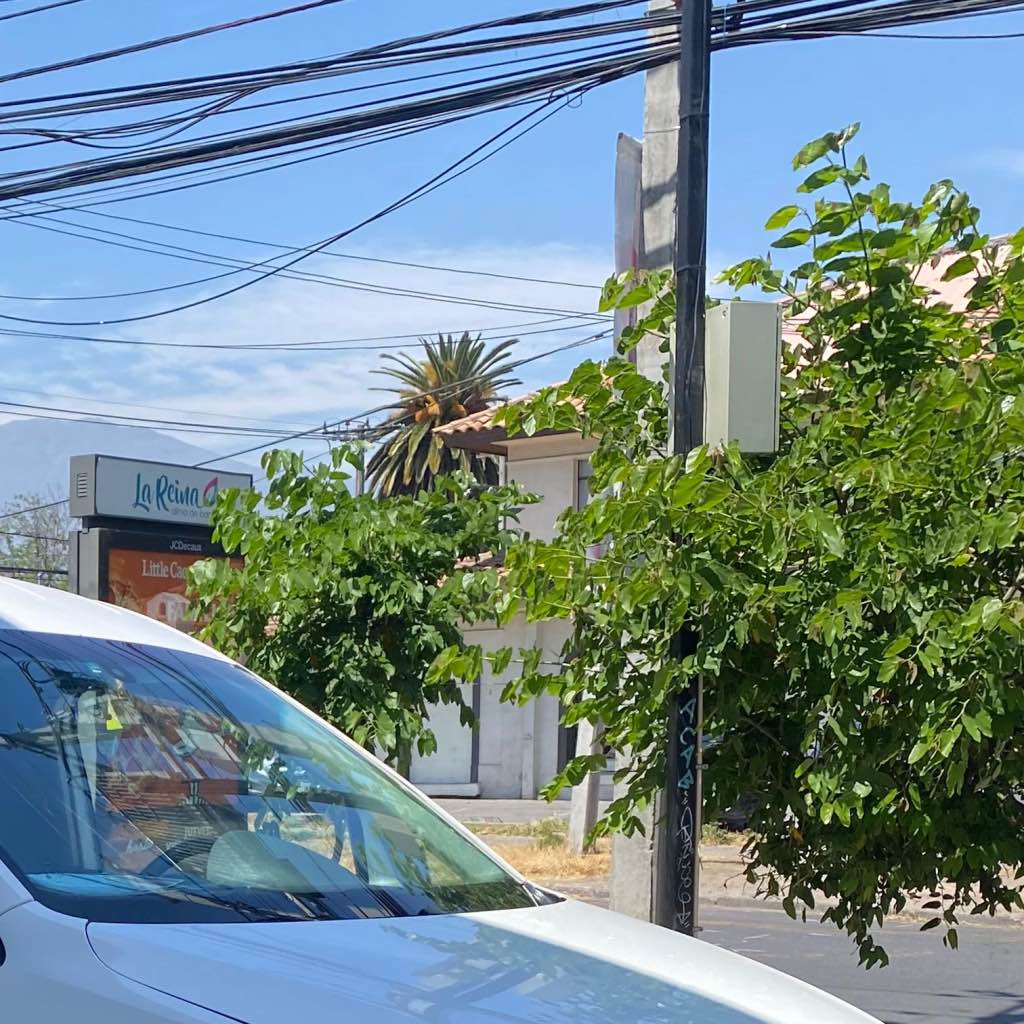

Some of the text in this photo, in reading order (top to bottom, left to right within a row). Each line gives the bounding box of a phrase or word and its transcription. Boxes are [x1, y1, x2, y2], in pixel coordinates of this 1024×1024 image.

[132, 473, 201, 512] La Reina
[142, 559, 169, 578] Little
